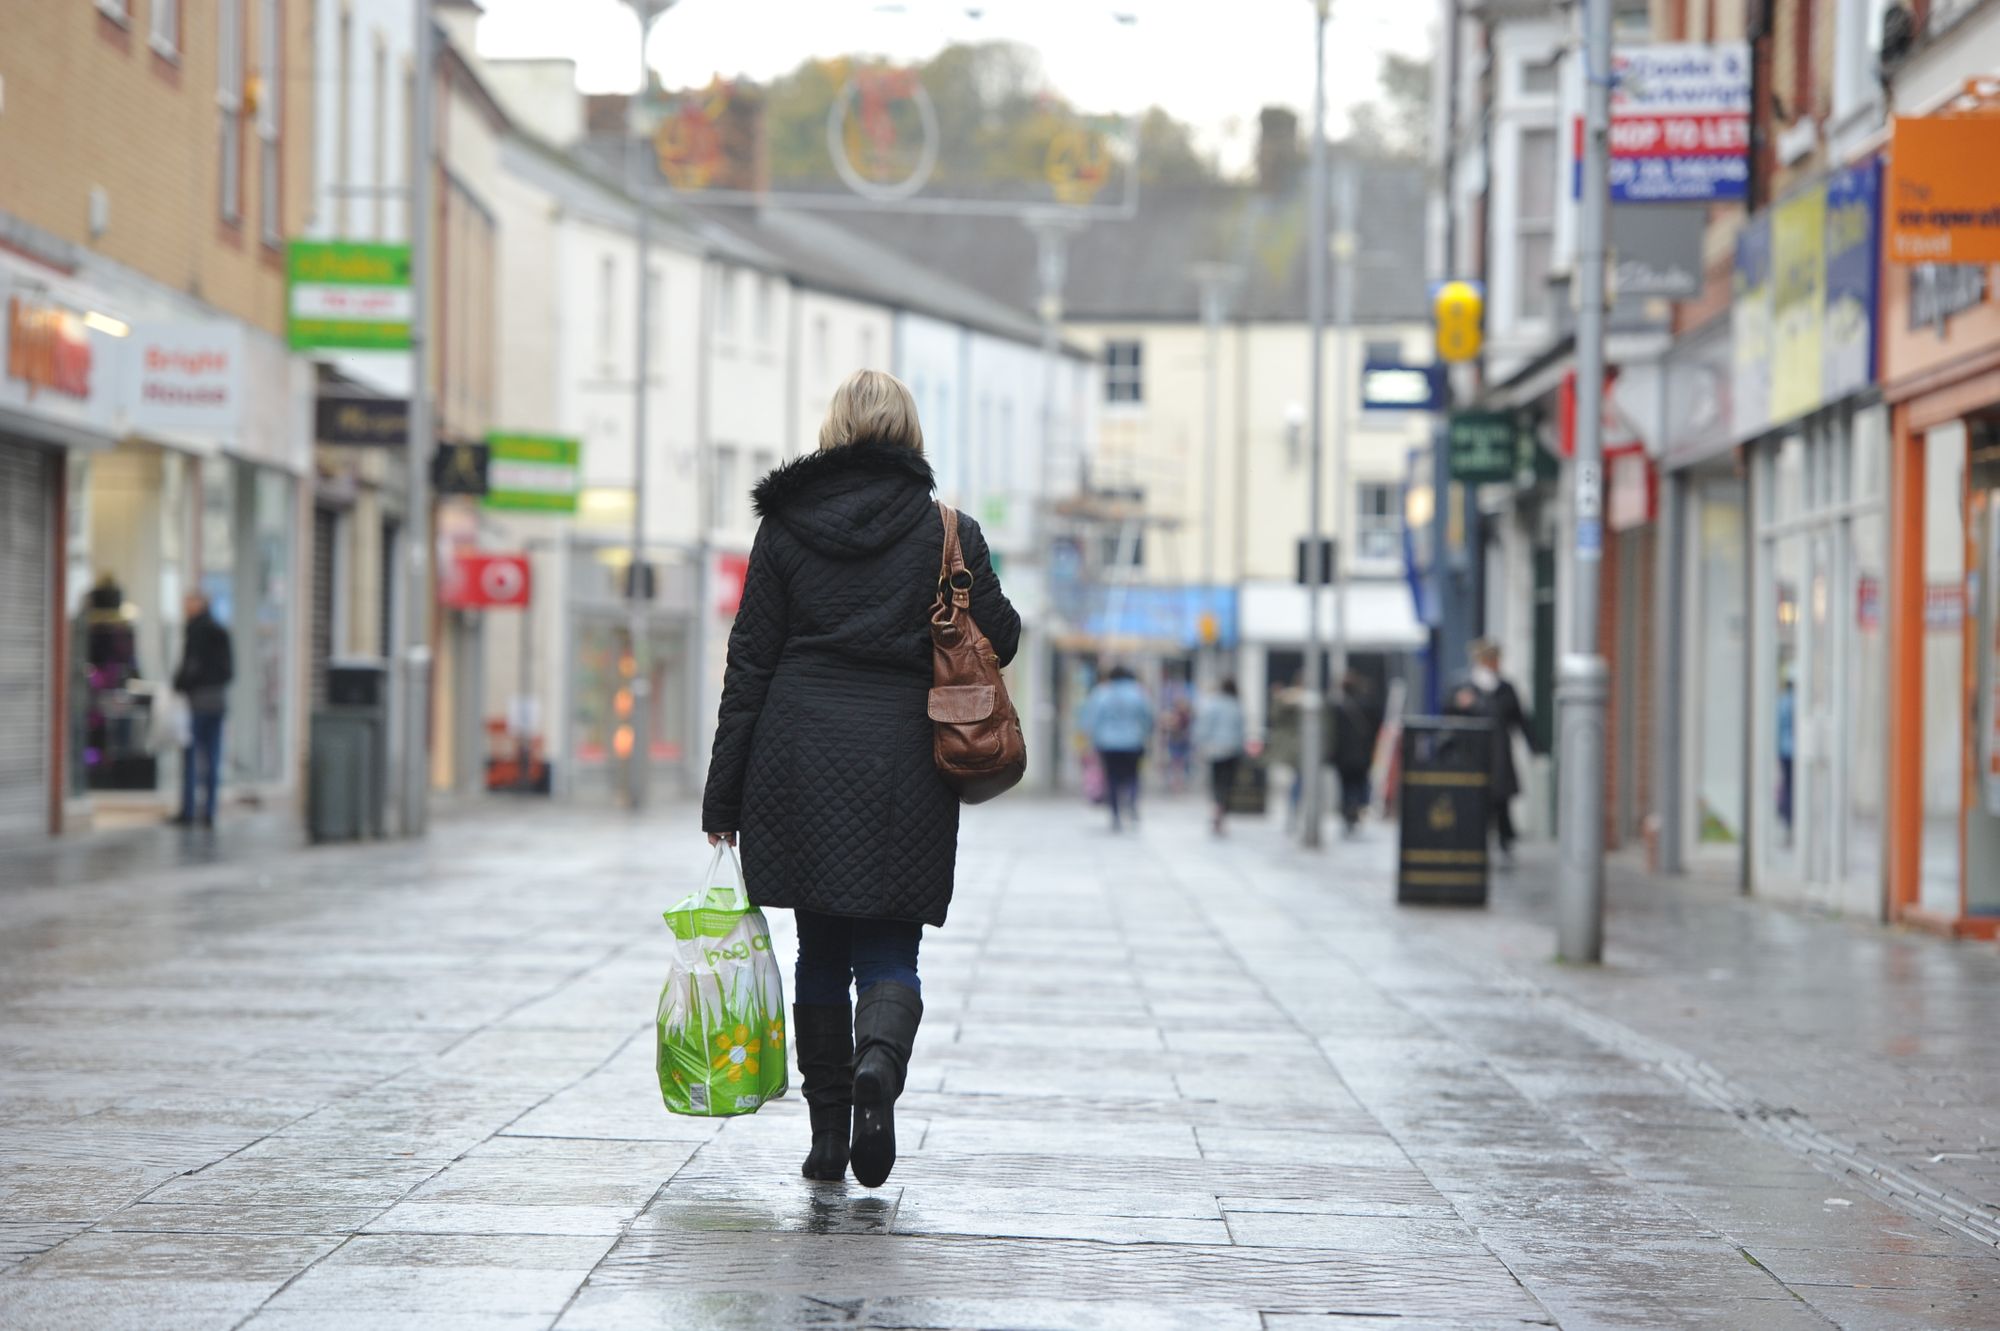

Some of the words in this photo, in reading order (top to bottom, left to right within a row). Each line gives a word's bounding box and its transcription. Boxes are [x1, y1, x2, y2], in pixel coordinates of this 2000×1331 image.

[1611, 121, 1660, 150] HOP
[1664, 121, 1699, 149] TO
[1703, 121, 1749, 149] LET
[144, 344, 229, 377] Bright
[142, 380, 228, 407] House
[703, 940, 750, 967] bag
[735, 1094, 760, 1109] ASD
